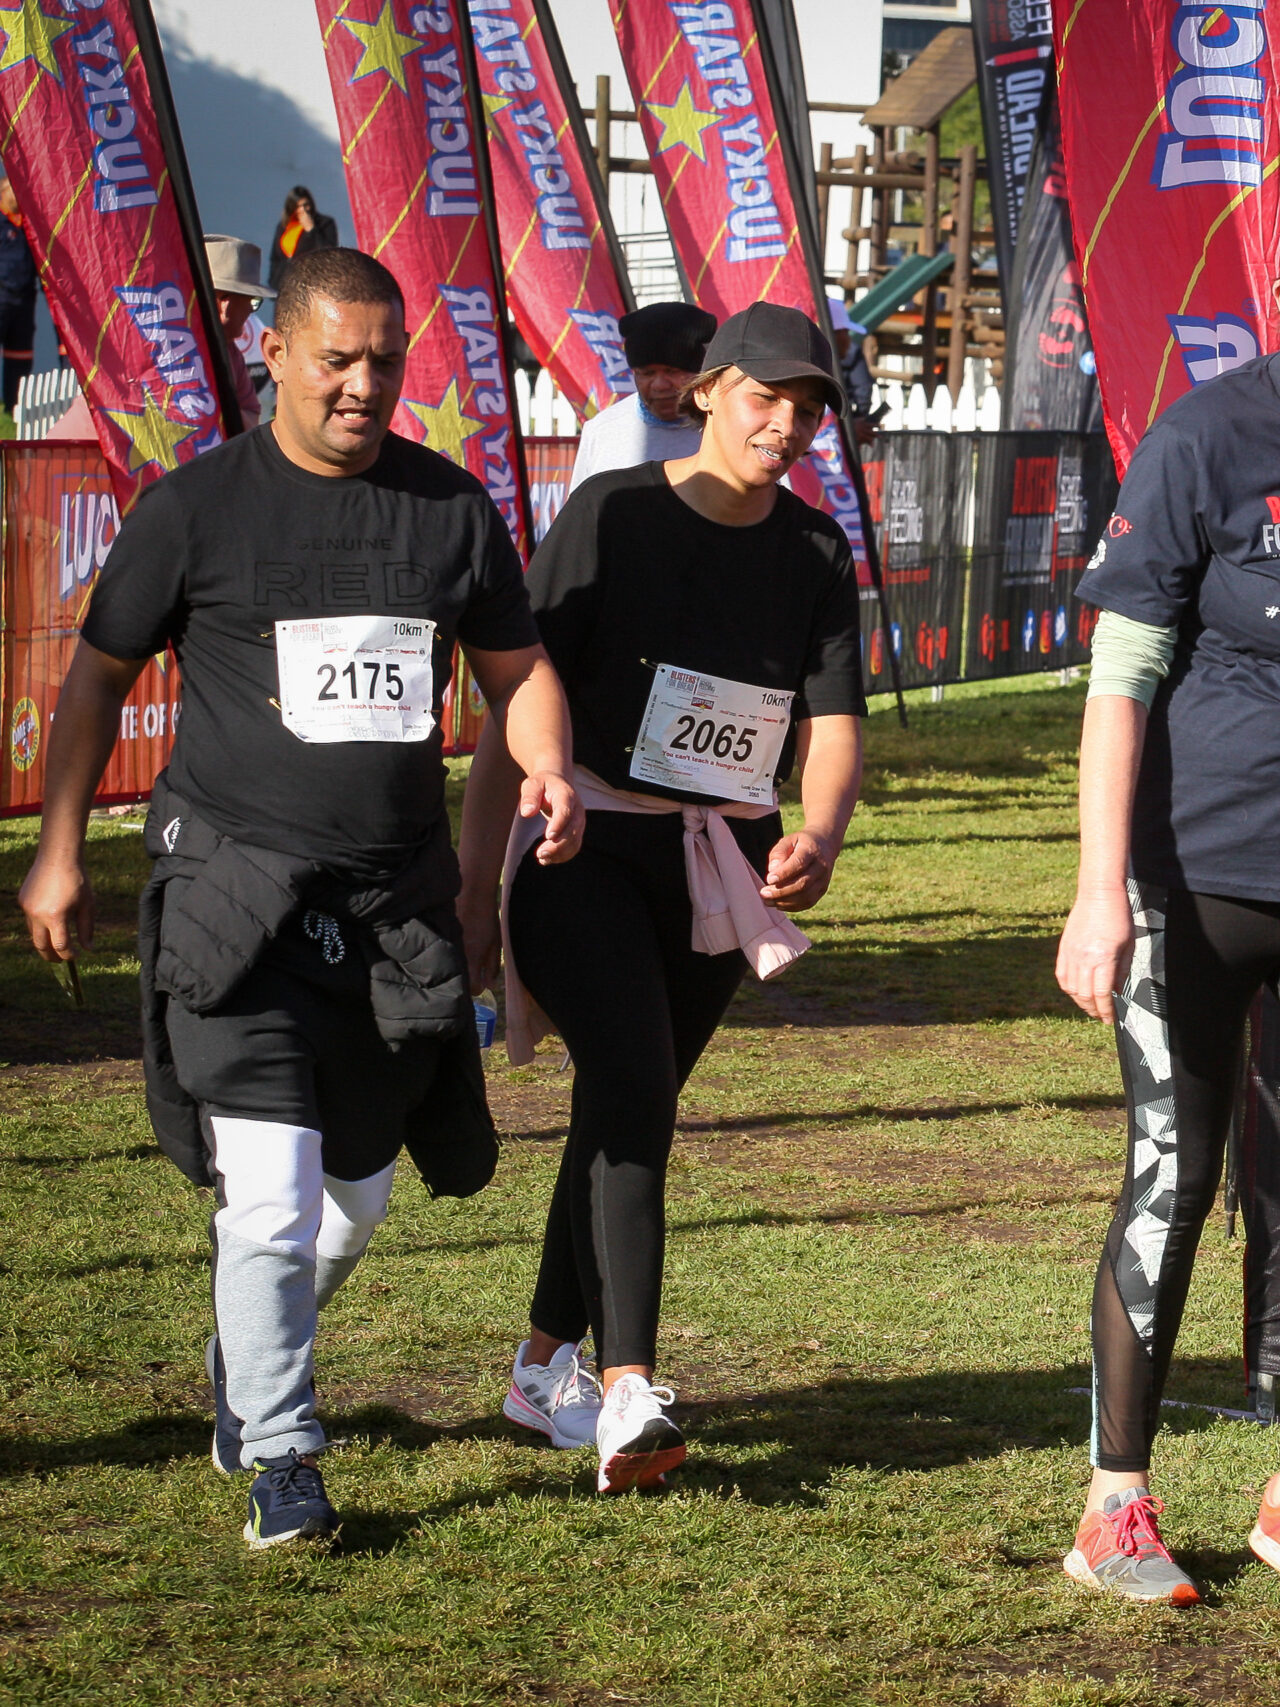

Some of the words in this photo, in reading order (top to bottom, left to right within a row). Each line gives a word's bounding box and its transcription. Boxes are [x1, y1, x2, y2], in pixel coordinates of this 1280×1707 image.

[60, 490, 122, 599] LUC
[296, 538, 393, 551] GENUINE
[253, 561, 436, 608] RED
[393, 622, 423, 637] 10km
[316, 661, 404, 701] 2175
[670, 670, 697, 685] BLISTERS
[760, 692, 786, 708] 10km
[143, 703, 168, 738] OF
[670, 714, 758, 763] 2065
[661, 750, 674, 758] You
[675, 753, 691, 762] can't
[692, 756, 709, 765] teach
[716, 761, 738, 773] hungry
[738, 765, 755, 774] child
